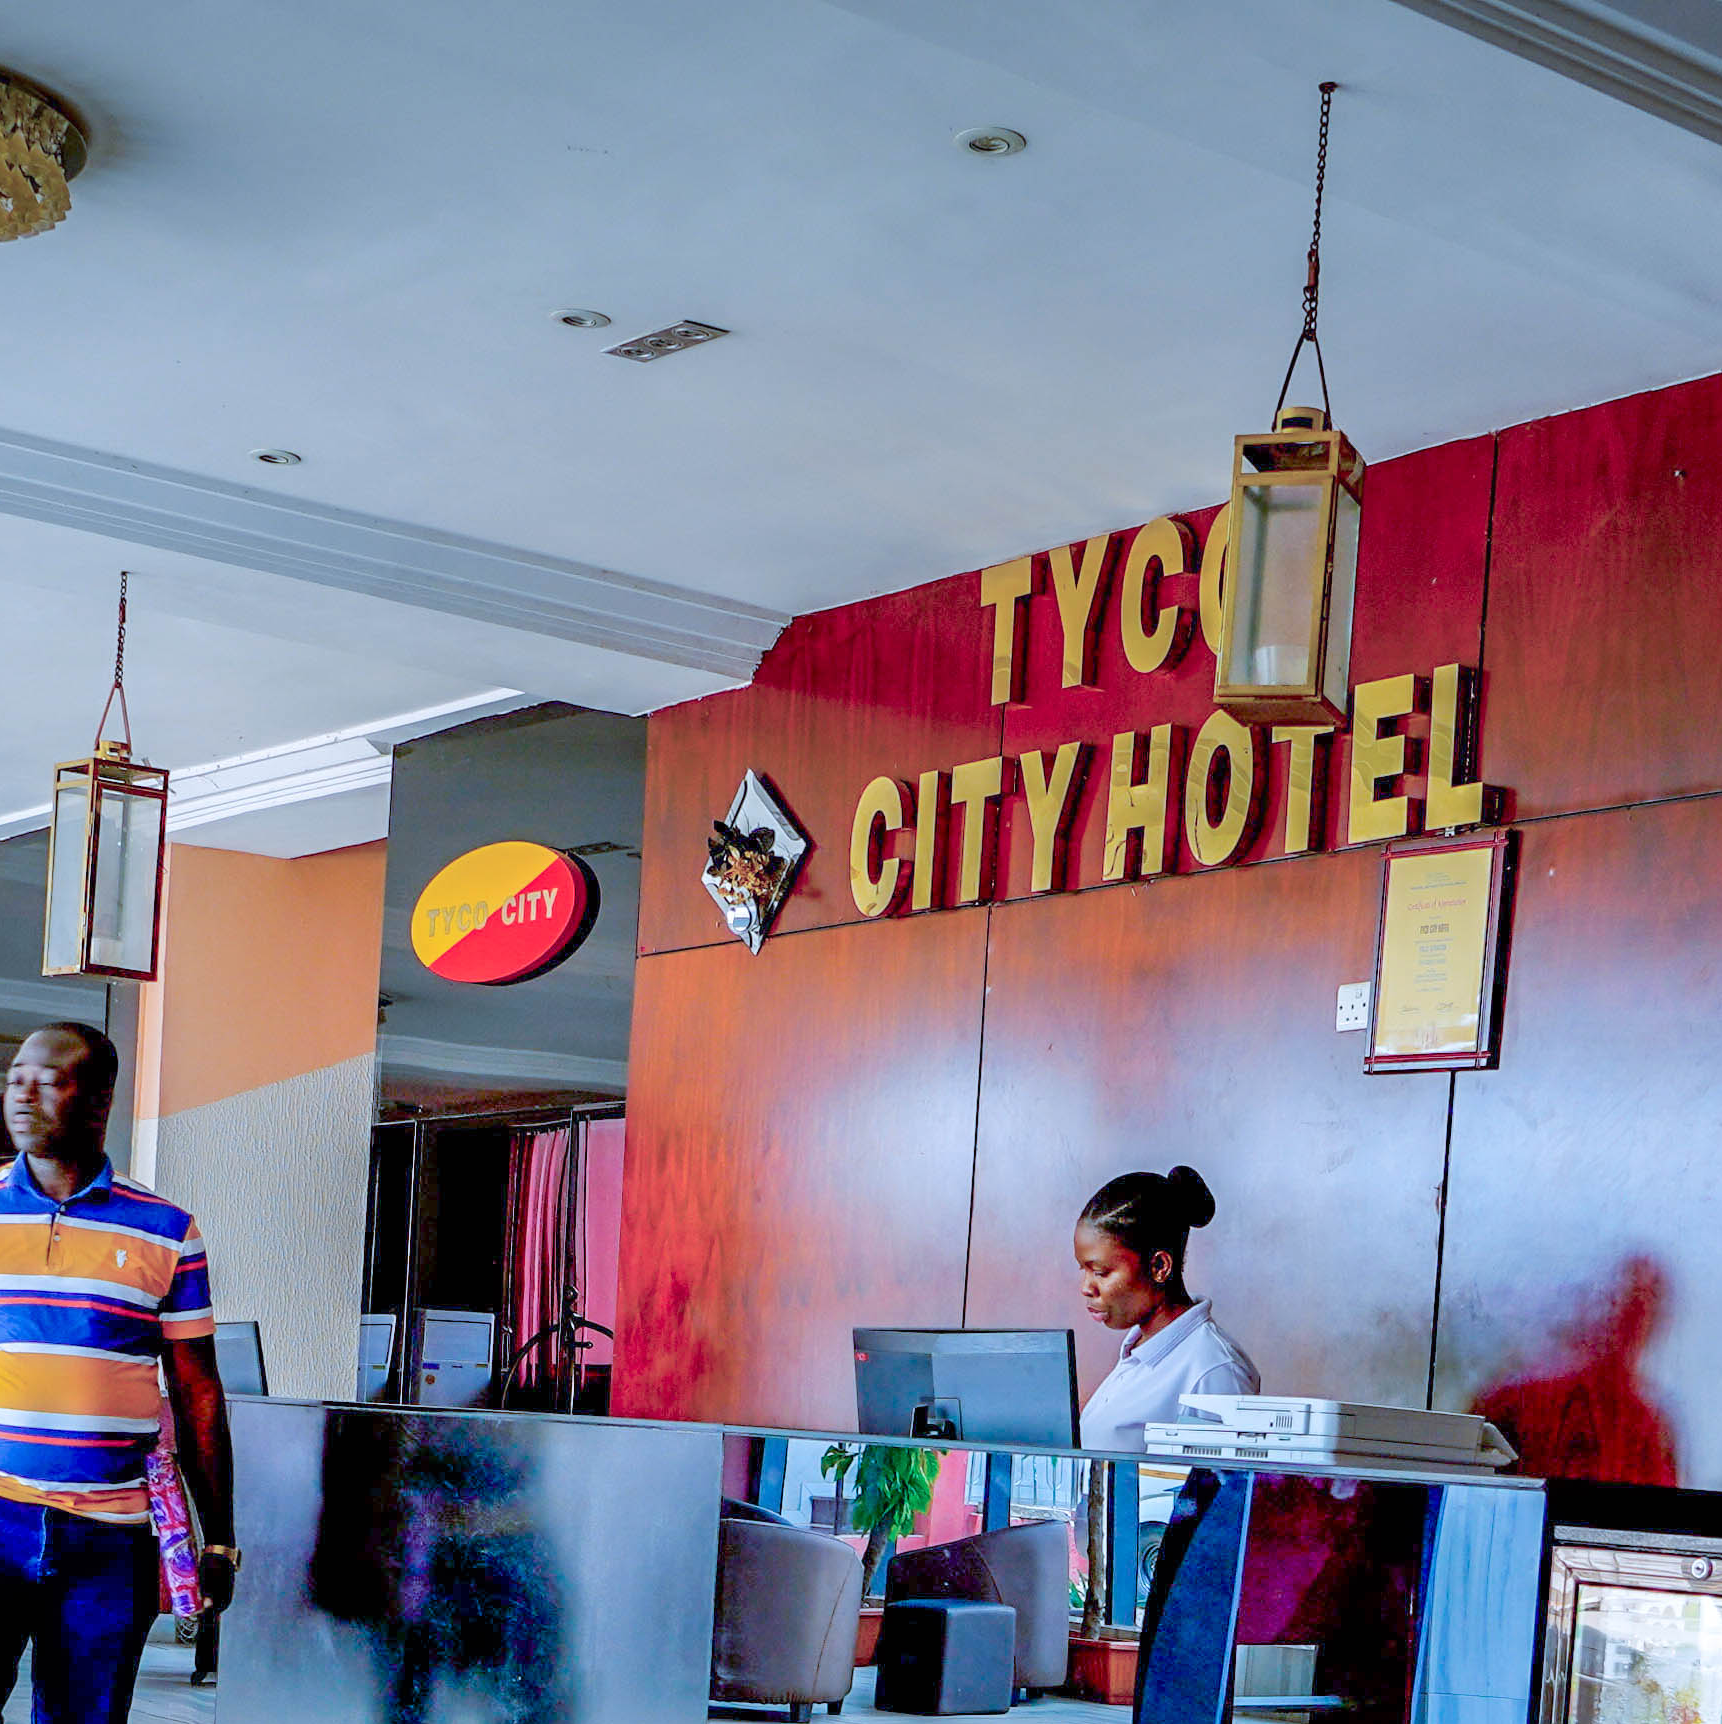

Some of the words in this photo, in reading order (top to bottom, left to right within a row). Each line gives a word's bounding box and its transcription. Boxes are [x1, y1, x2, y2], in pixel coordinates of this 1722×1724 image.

[851, 741, 1081, 917] CITY
[1102, 663, 1484, 881] HOTEL
[427, 900, 489, 938] TYCO
[501, 887, 559, 926] CITY
